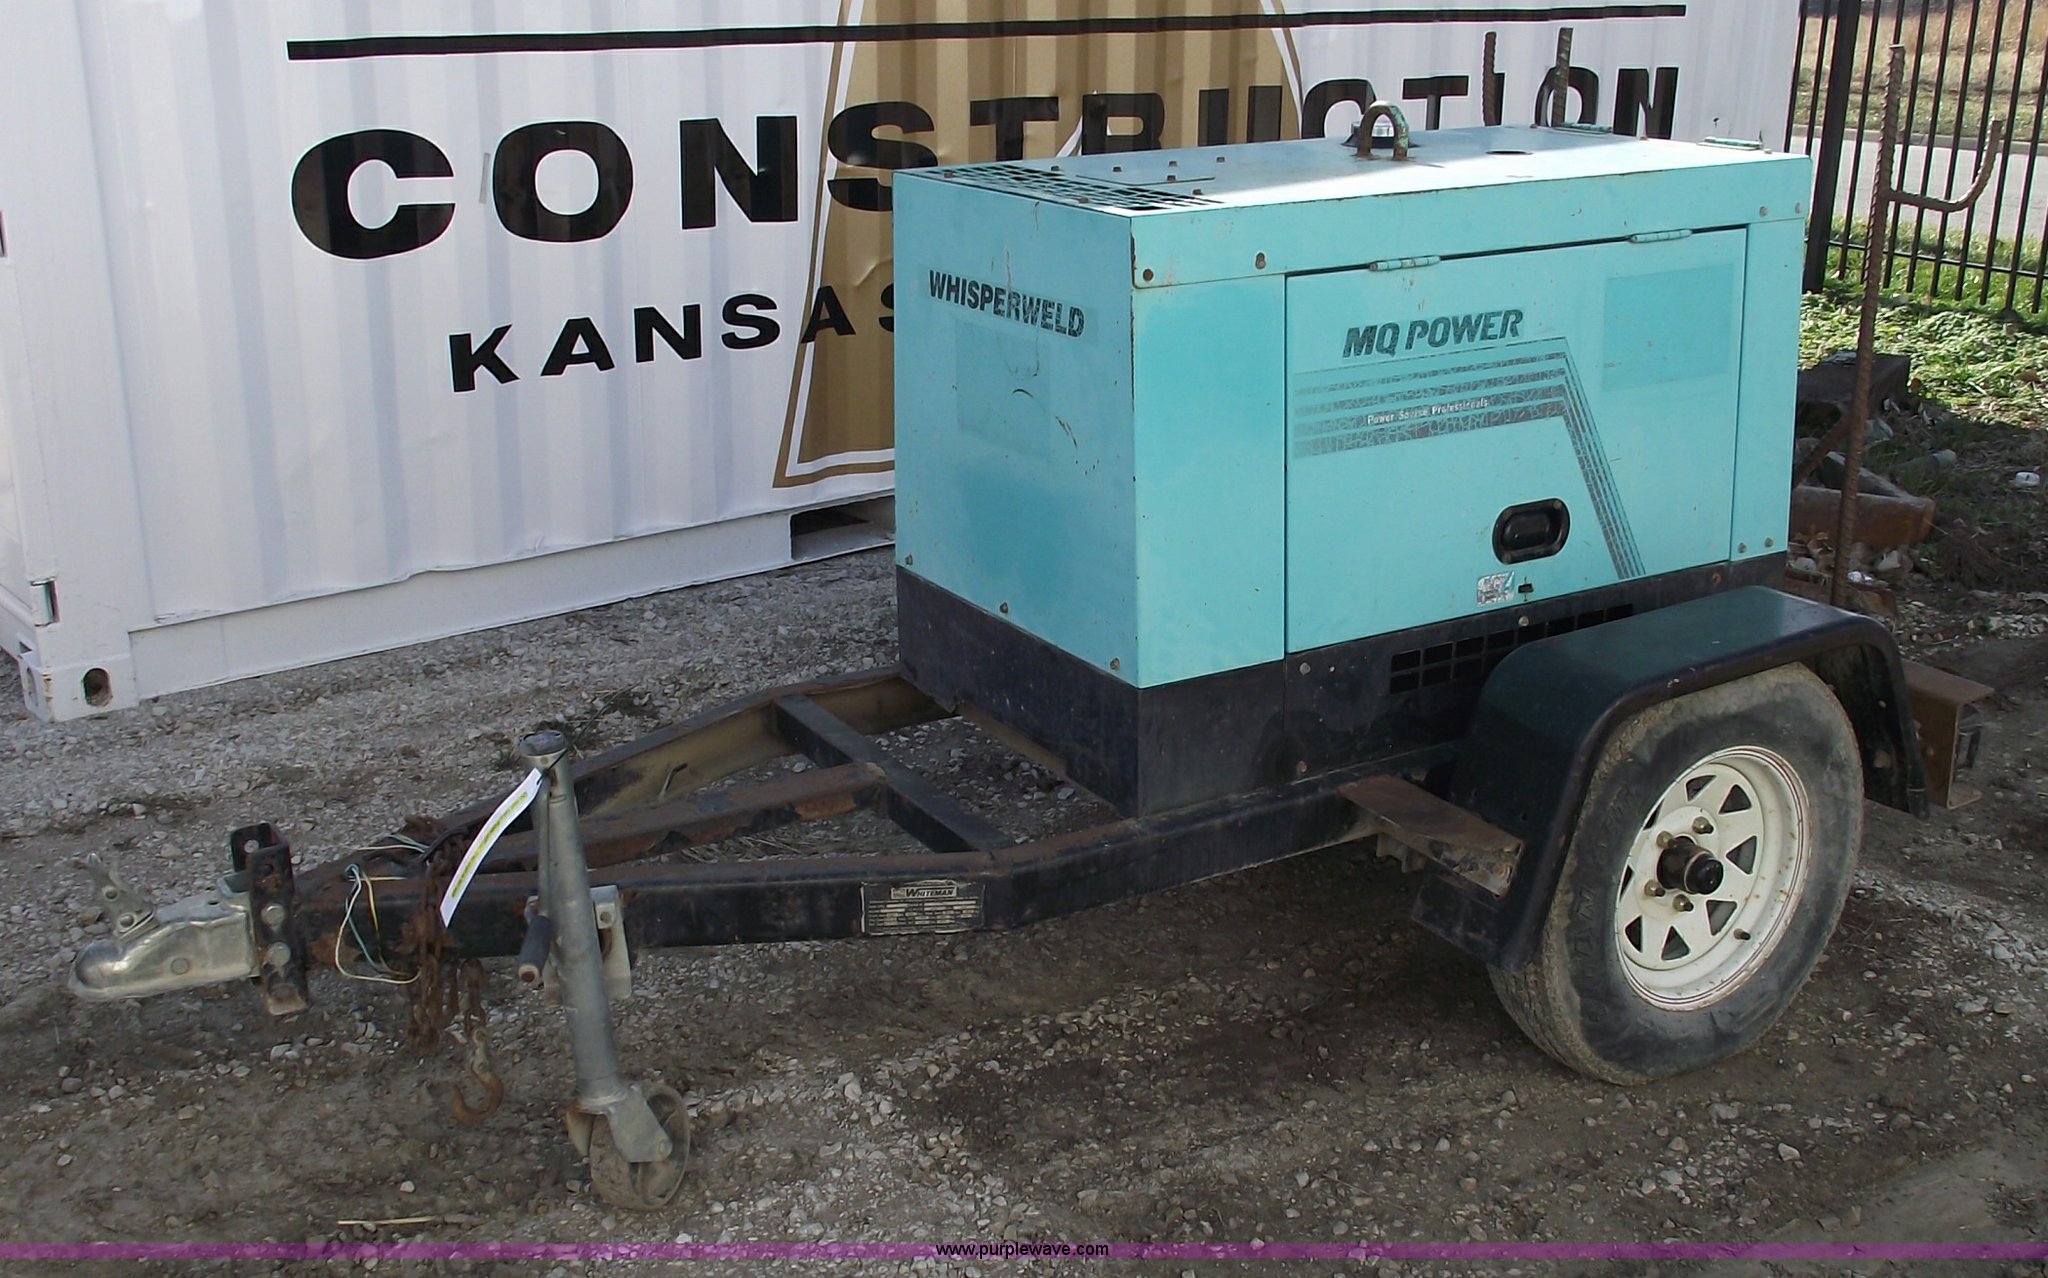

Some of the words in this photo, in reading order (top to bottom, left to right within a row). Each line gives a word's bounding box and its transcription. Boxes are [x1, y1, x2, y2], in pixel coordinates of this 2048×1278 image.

[929, 269, 1085, 338] WHISPERWELD
[1342, 323, 1400, 358] MQ
[1405, 309, 1524, 351] POWER
[448, 286, 895, 393] KANSA
